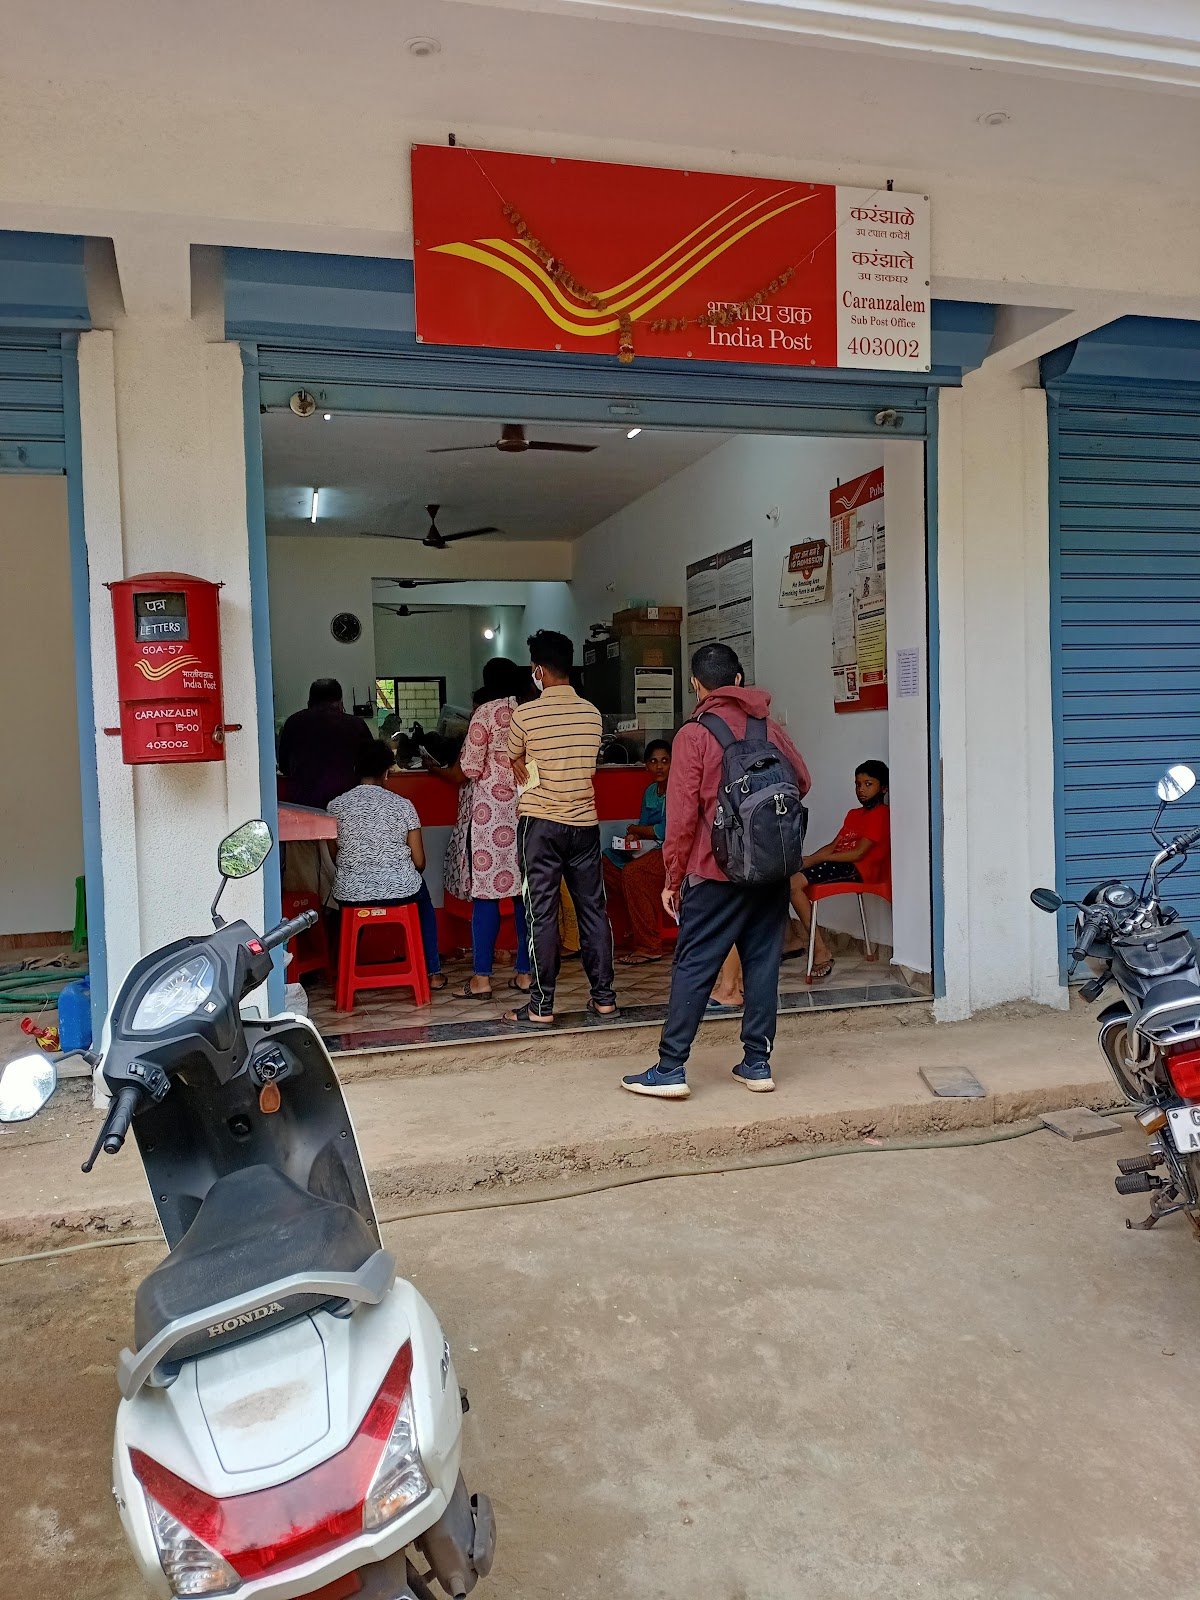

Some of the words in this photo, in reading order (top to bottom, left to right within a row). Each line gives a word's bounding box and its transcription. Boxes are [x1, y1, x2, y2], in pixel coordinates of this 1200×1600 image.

[849, 204, 915, 226] करंझाळे
[855, 228, 866, 237] उप
[867, 229, 887, 238] टपाल
[851, 248, 915, 269] करंझाले
[858, 272, 871, 281] उप
[874, 273, 908, 283] डाकघर
[842, 290, 926, 313] Caranzalem
[776, 305, 812, 325] डाक
[850, 314, 868, 325] Sub
[870, 316, 888, 327] Post
[890, 317, 916, 328] Office
[707, 324, 765, 348] India
[768, 328, 813, 351] Post
[847, 336, 920, 358] 403002
[144, 599, 167, 612] पत्र
[140, 622, 181, 636] LETTERS
[142, 645, 184, 655] GOA-57
[183, 678, 202, 689] India
[203, 679, 217, 690] Post
[135, 708, 199, 720] CARANZALEM
[175, 723, 200, 732] 15-00
[146, 740, 189, 750] 403002
[206, 1302, 285, 1338] HONDA
